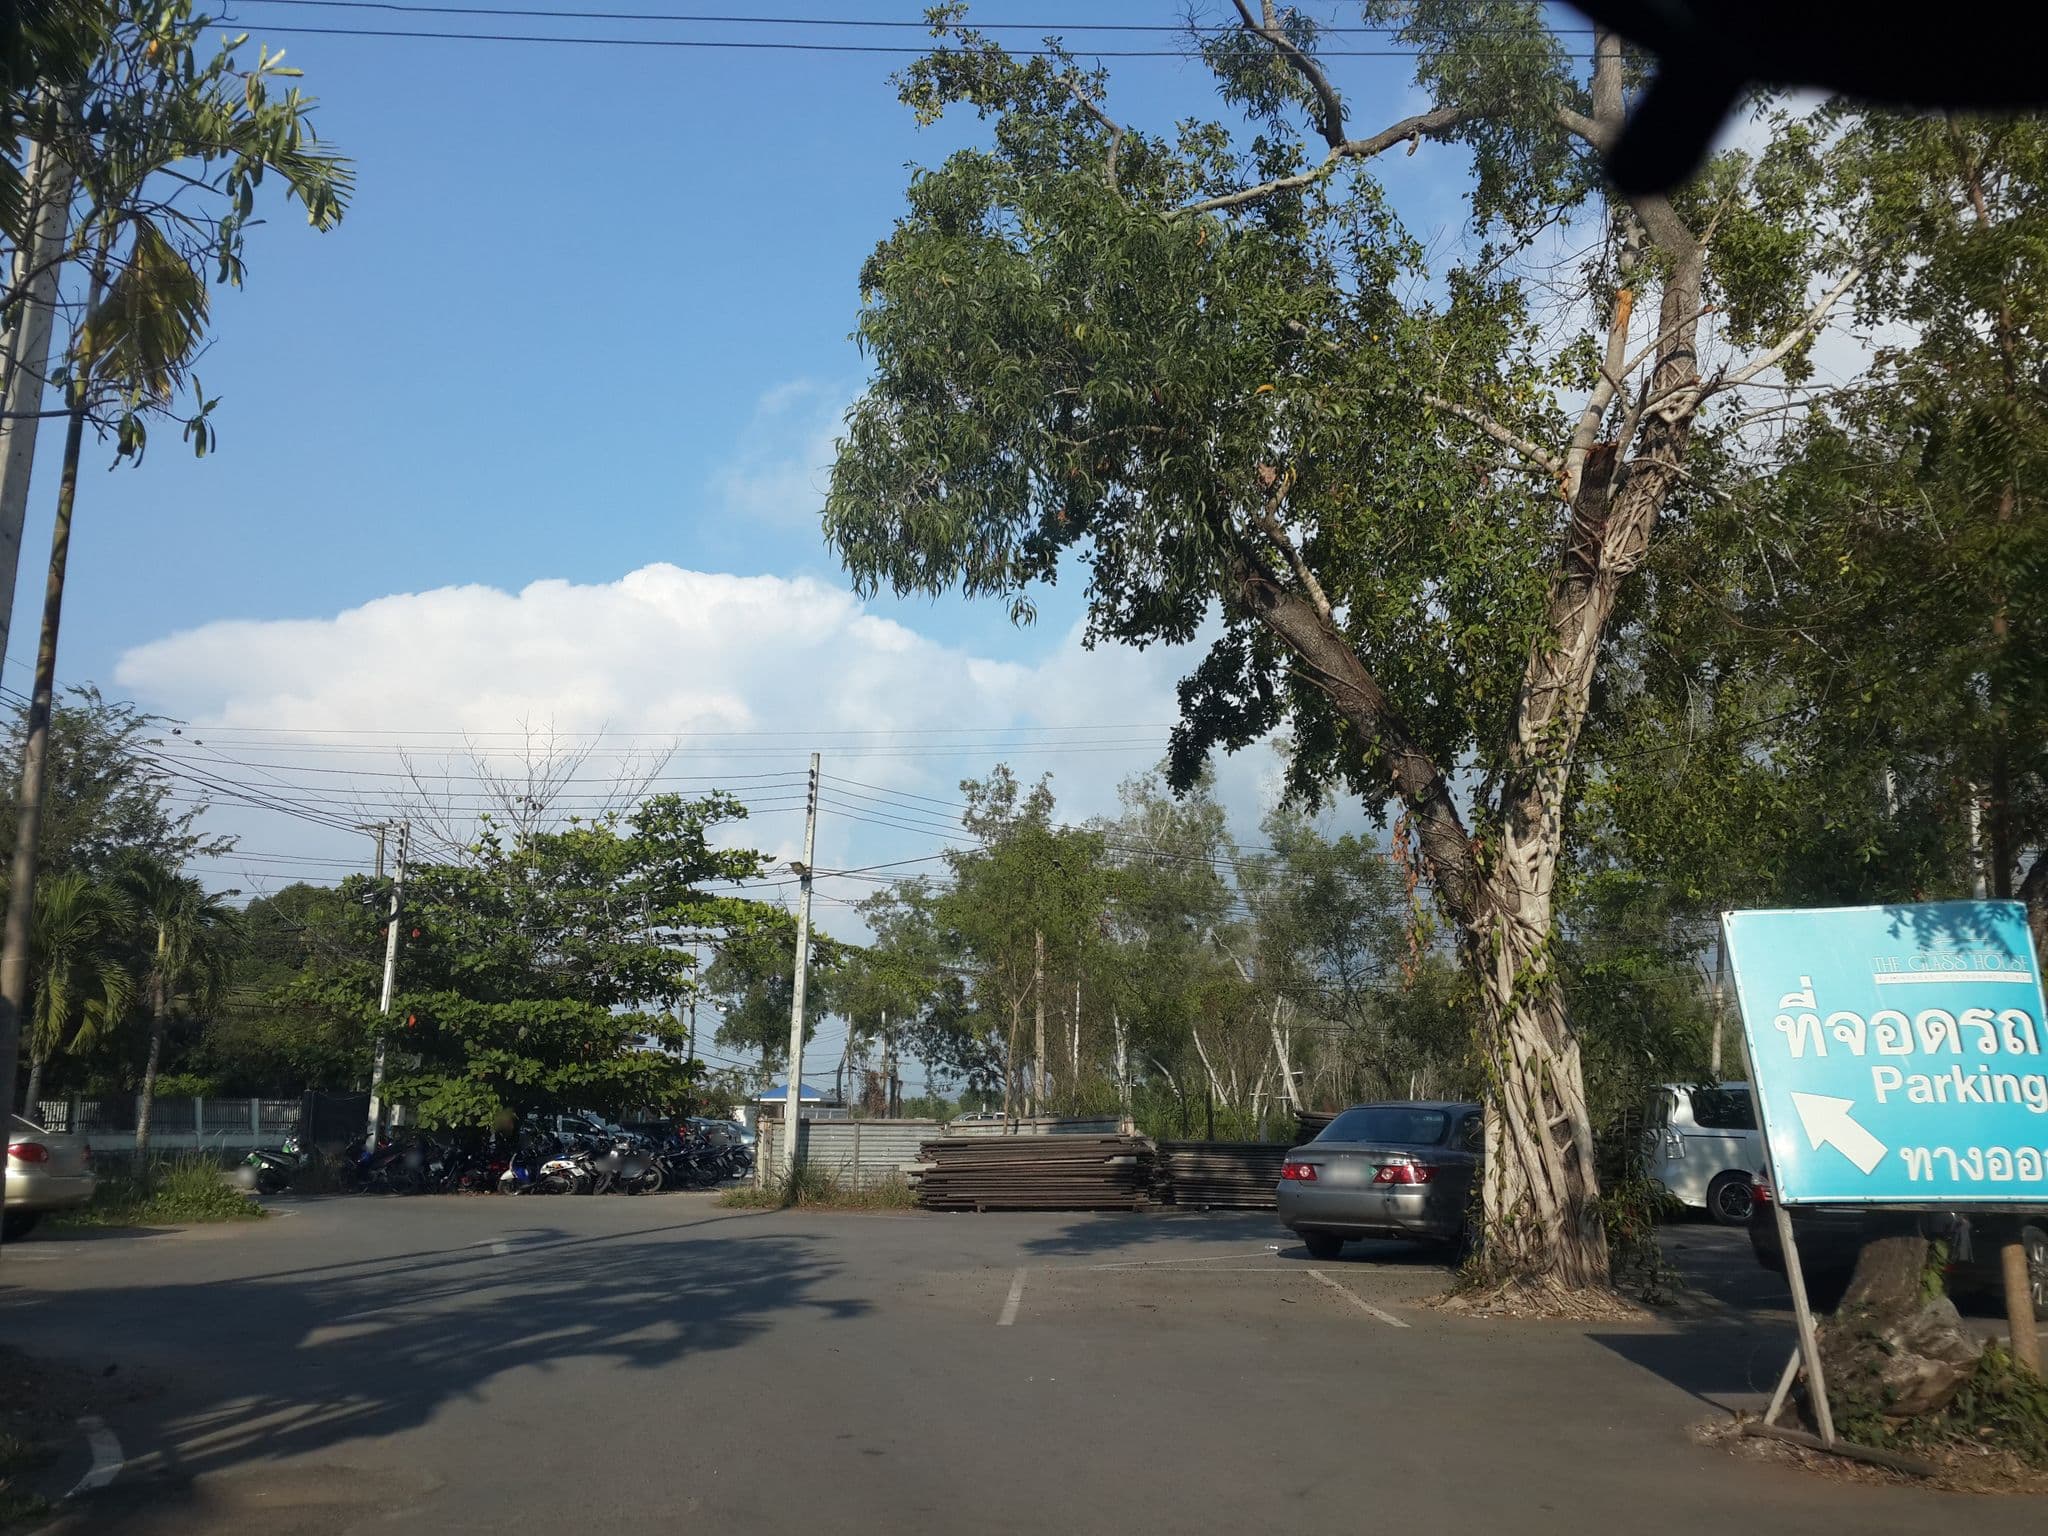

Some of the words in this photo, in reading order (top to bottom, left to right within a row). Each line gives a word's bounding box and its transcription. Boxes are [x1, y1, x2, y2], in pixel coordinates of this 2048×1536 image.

[1873, 957, 1900, 972] THE
[1907, 955, 1967, 971] GLASS
[1974, 954, 2029, 971] HOUSE
[1774, 976, 2040, 1058] ที่จอดรถ
[1871, 1064, 2048, 1114] Parking
[1899, 1146, 2048, 1181] ทางออ
